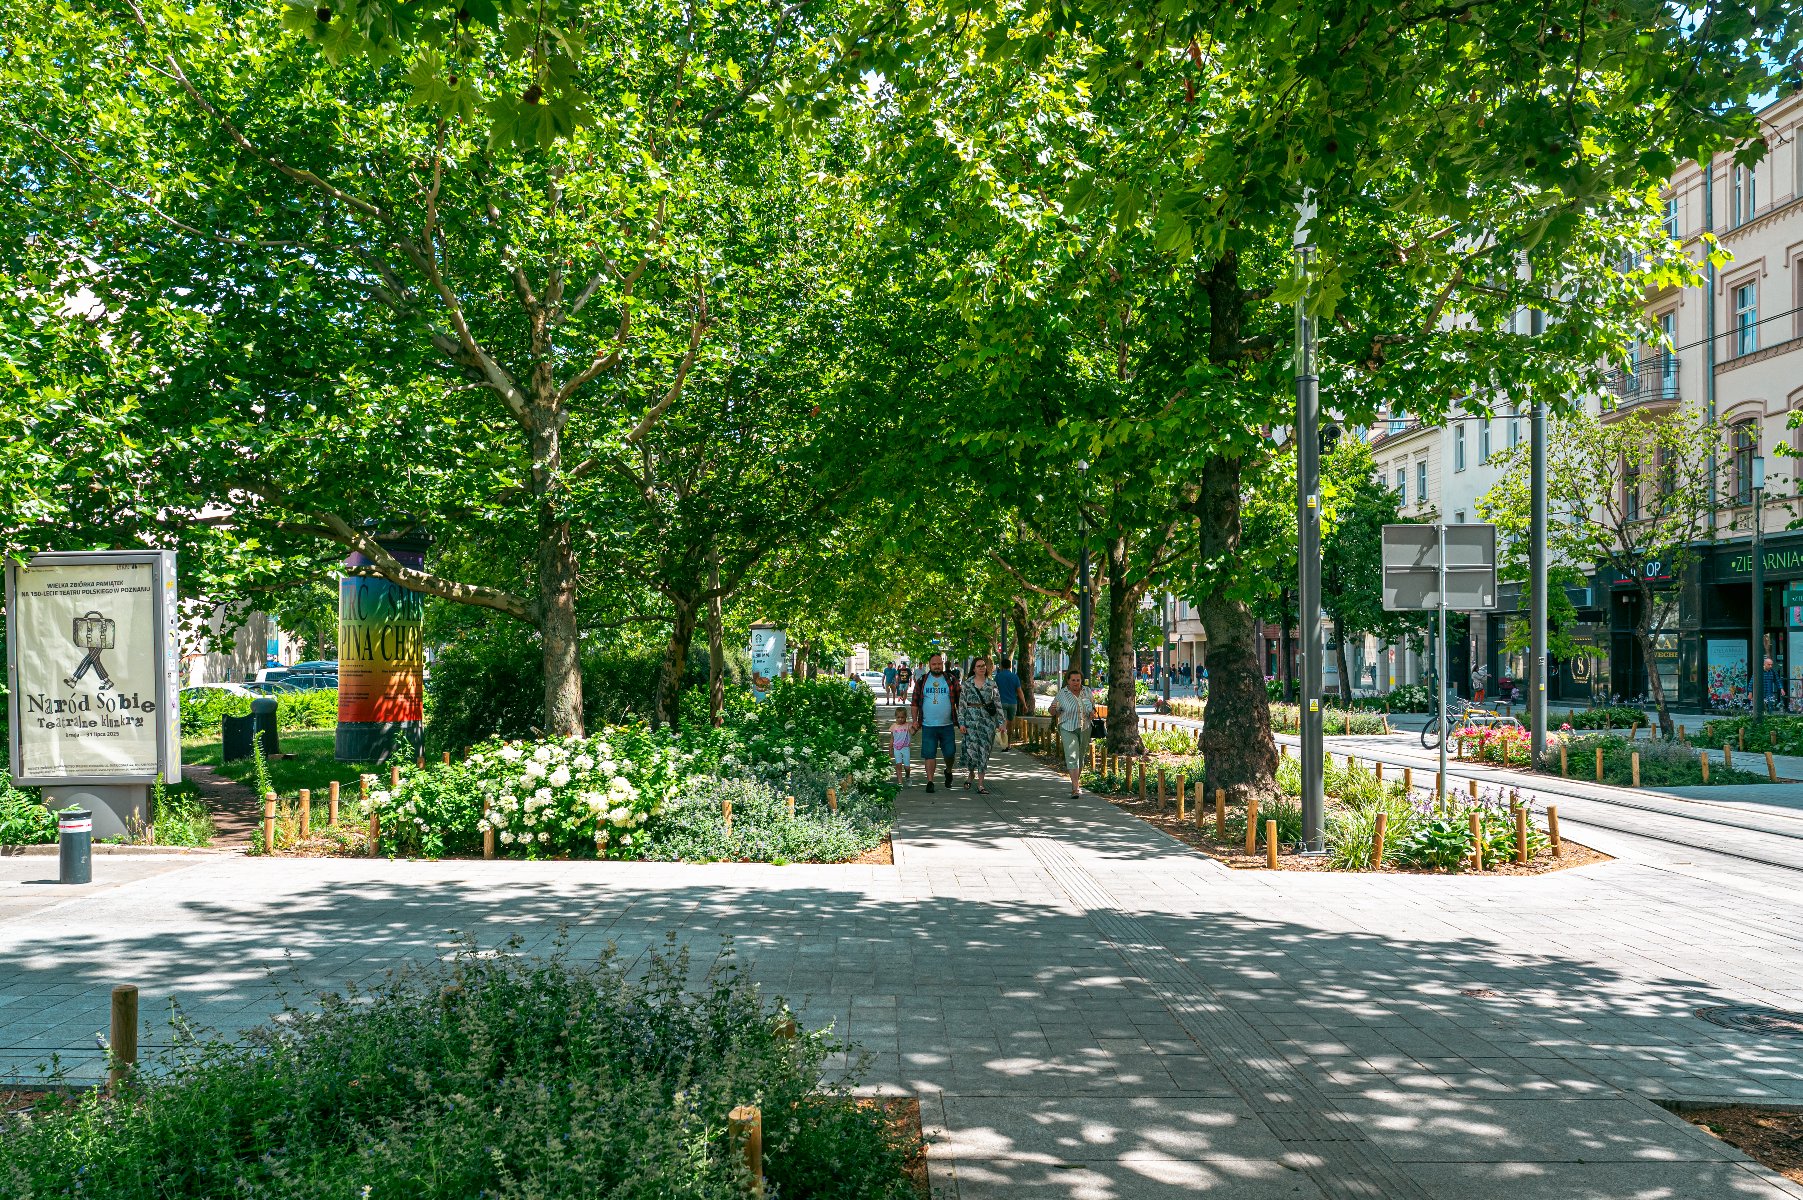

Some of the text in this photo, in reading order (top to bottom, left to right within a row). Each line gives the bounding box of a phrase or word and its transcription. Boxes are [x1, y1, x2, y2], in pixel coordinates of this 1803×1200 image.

[341, 624, 374, 661] PINA
[27, 692, 156, 714] Naród Sobie
[37, 715, 98, 729] Teatralne
